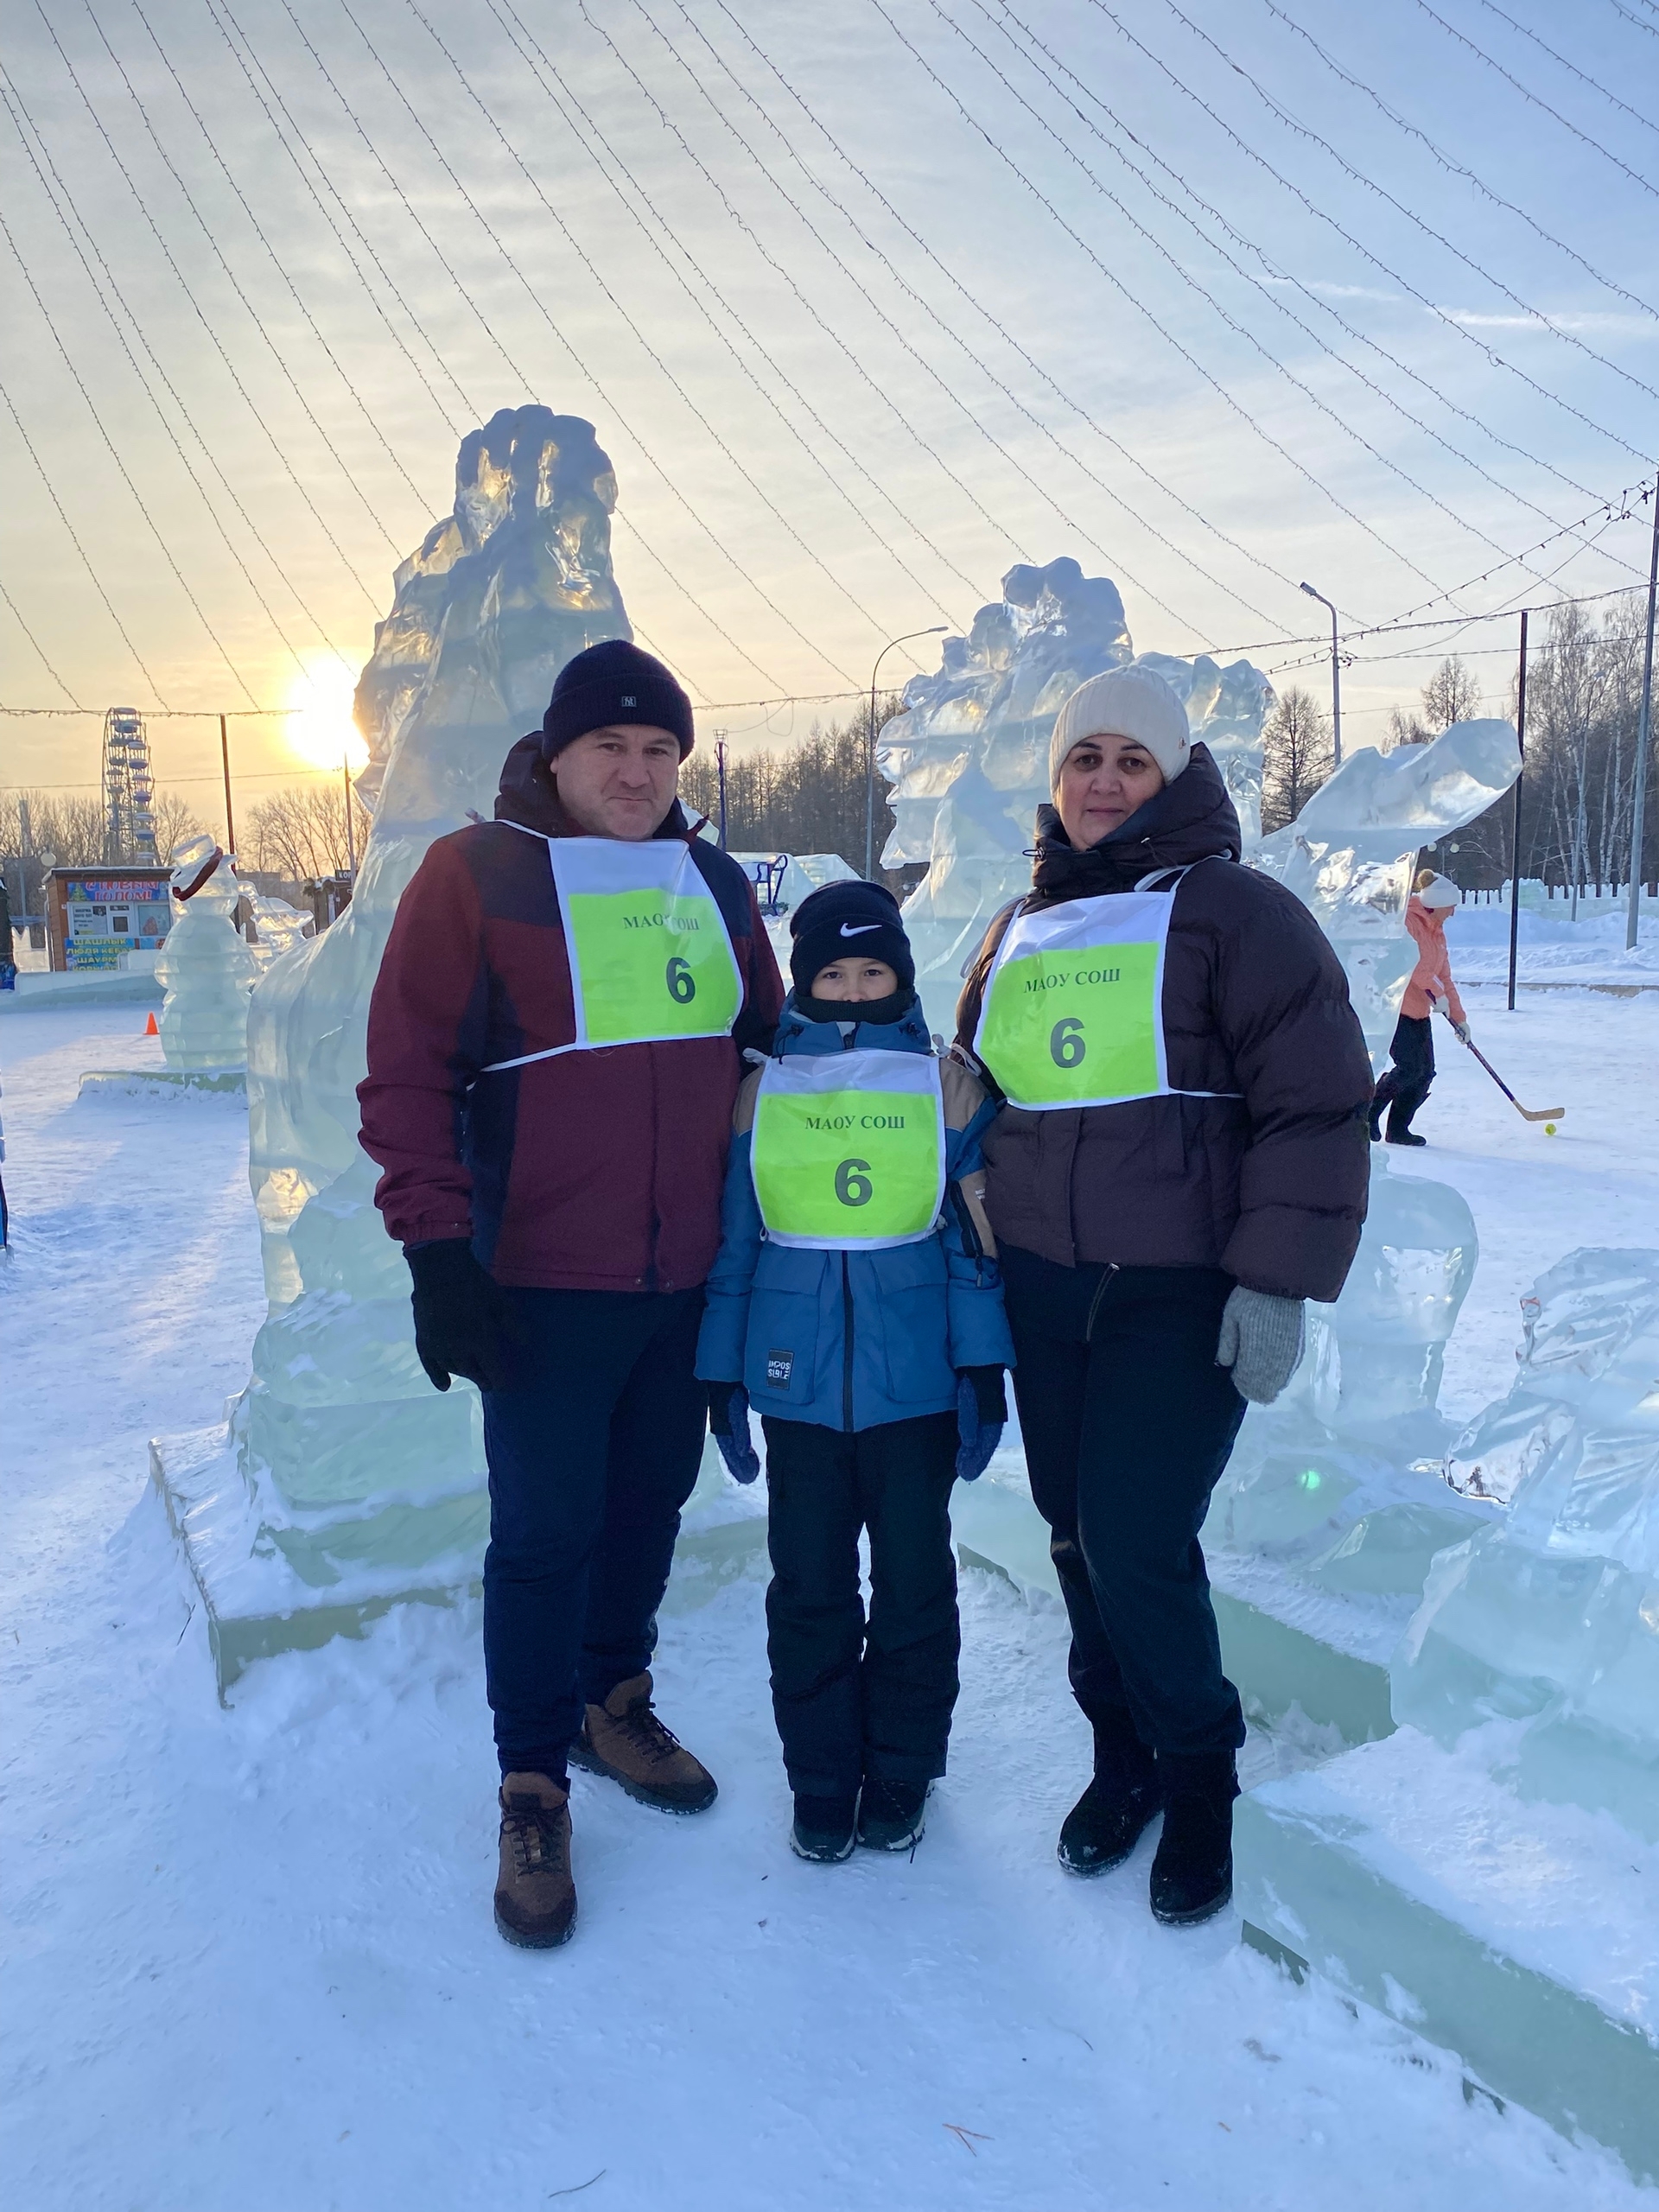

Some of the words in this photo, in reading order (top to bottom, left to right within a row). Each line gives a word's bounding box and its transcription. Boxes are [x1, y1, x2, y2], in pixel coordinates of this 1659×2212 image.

[665, 957, 696, 1004] 6
[1023, 973, 1071, 993] МАОУ
[1075, 968, 1121, 985] СОШ
[1050, 1017, 1086, 1069] 6
[804, 1116, 855, 1129] МАОУ
[861, 1116, 906, 1129] СОШ
[835, 1158, 873, 1206] 6
